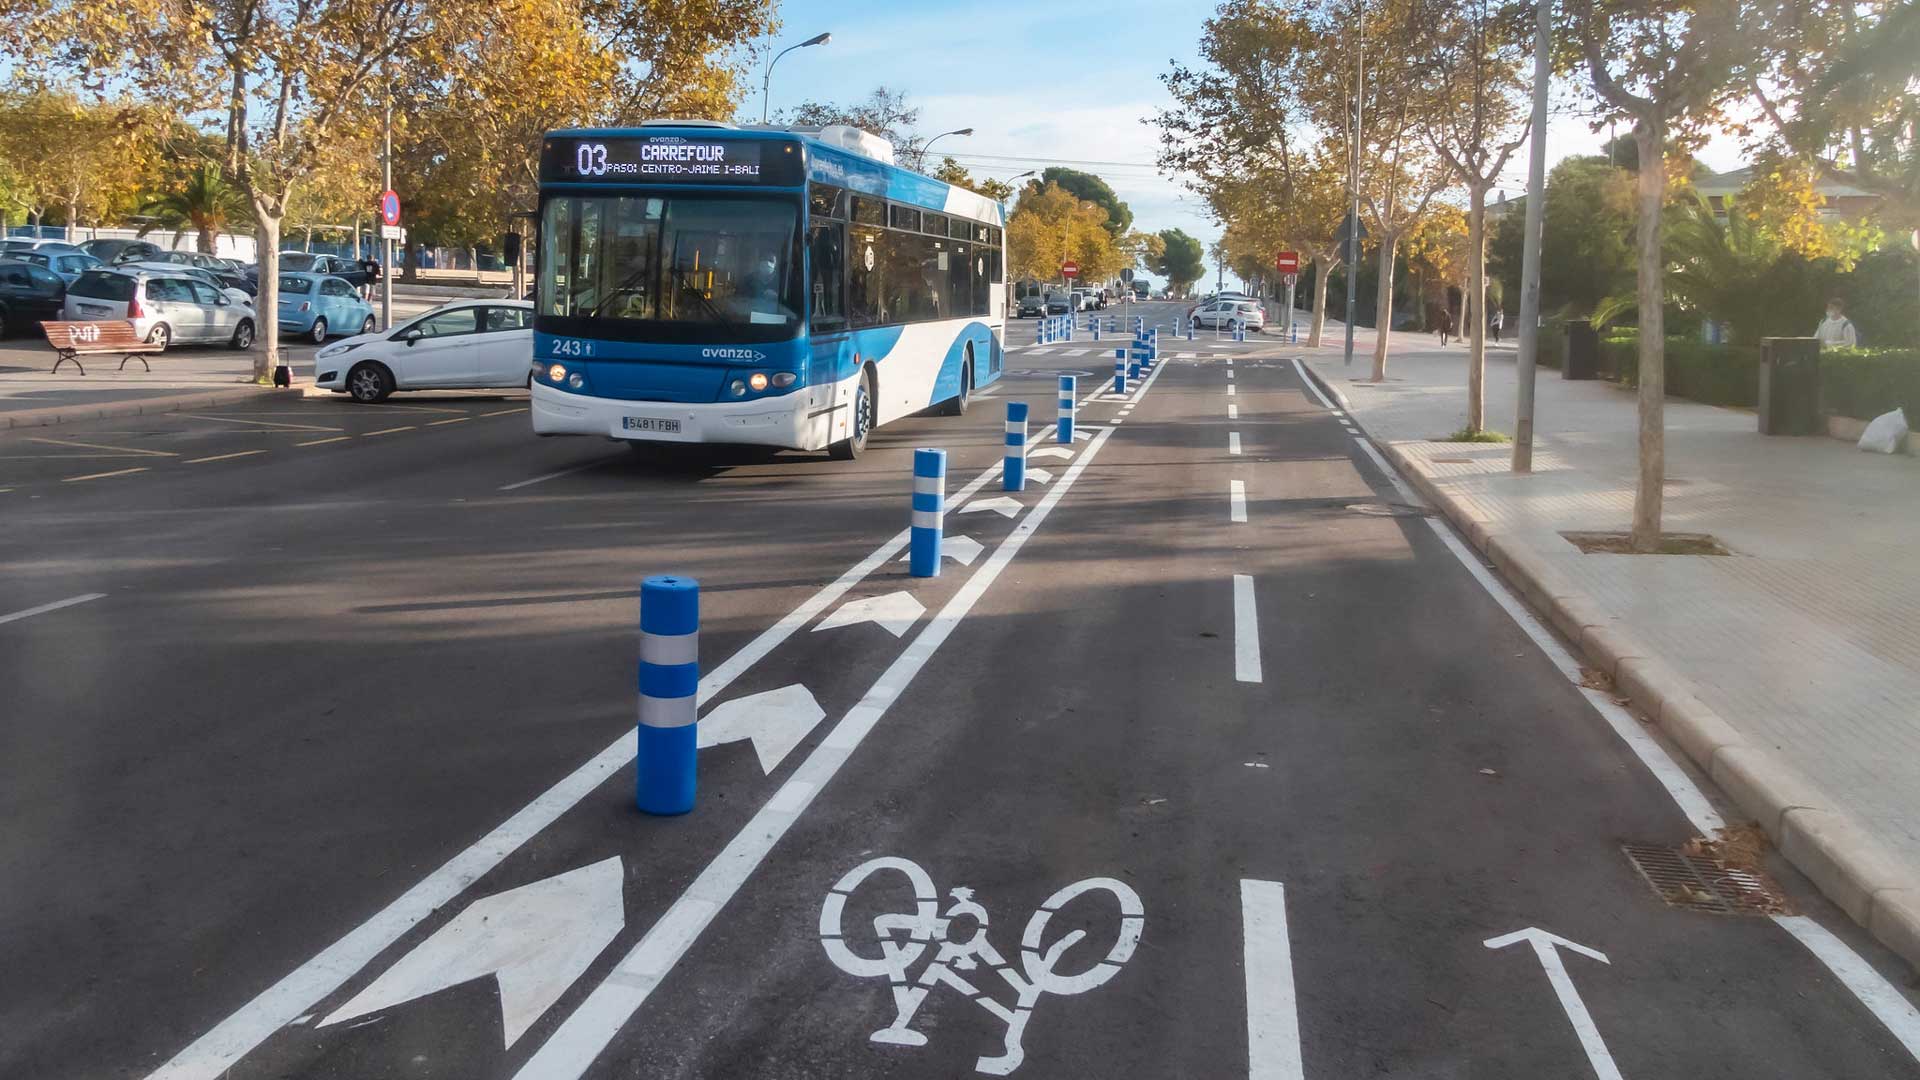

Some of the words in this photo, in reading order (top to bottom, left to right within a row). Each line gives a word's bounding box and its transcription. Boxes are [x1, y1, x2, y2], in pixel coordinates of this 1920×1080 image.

[577, 144, 607, 175] 03
[641, 145, 725, 161] CARREFOUR
[606, 163, 637, 173] PASO:
[641, 164, 721, 174] CENTRO-JAIME
[552, 339, 581, 356] 243
[702, 348, 753, 359] avanza
[629, 418, 655, 429] 5481
[658, 420, 679, 431] FBH
